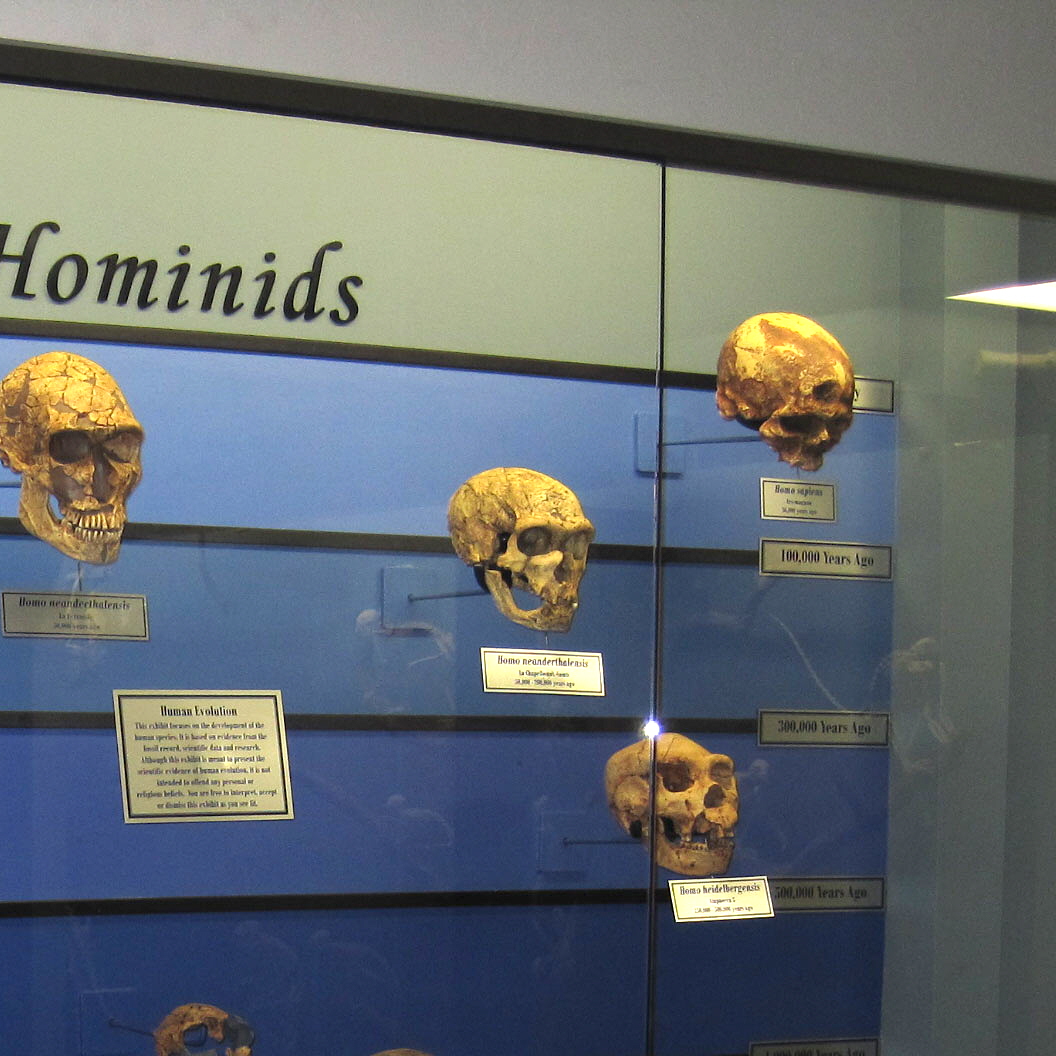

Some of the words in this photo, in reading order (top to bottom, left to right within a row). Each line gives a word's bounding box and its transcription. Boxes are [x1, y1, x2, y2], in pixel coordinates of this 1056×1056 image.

[775, 484, 795, 495] Homo
[797, 486, 823, 497] sapiens
[781, 549, 820, 563] 100,000
[823, 551, 851, 565] Years
[854, 553, 874, 567] Ago
[19, 597, 46, 607] Homo
[50, 599, 130, 610] neanderthalensis
[498, 656, 520, 664] Homo
[523, 657, 588, 668] neanderthalensis
[161, 705, 192, 716] Human
[195, 705, 237, 716] Evolution
[778, 720, 817, 733] 300,000
[820, 721, 848, 734] Years
[852, 722, 871, 736] Ago
[680, 885, 701, 895] Homo
[703, 882, 761, 896] heidelbergensis
[817, 886, 844, 898] Years
[848, 886, 868, 900] Ago
